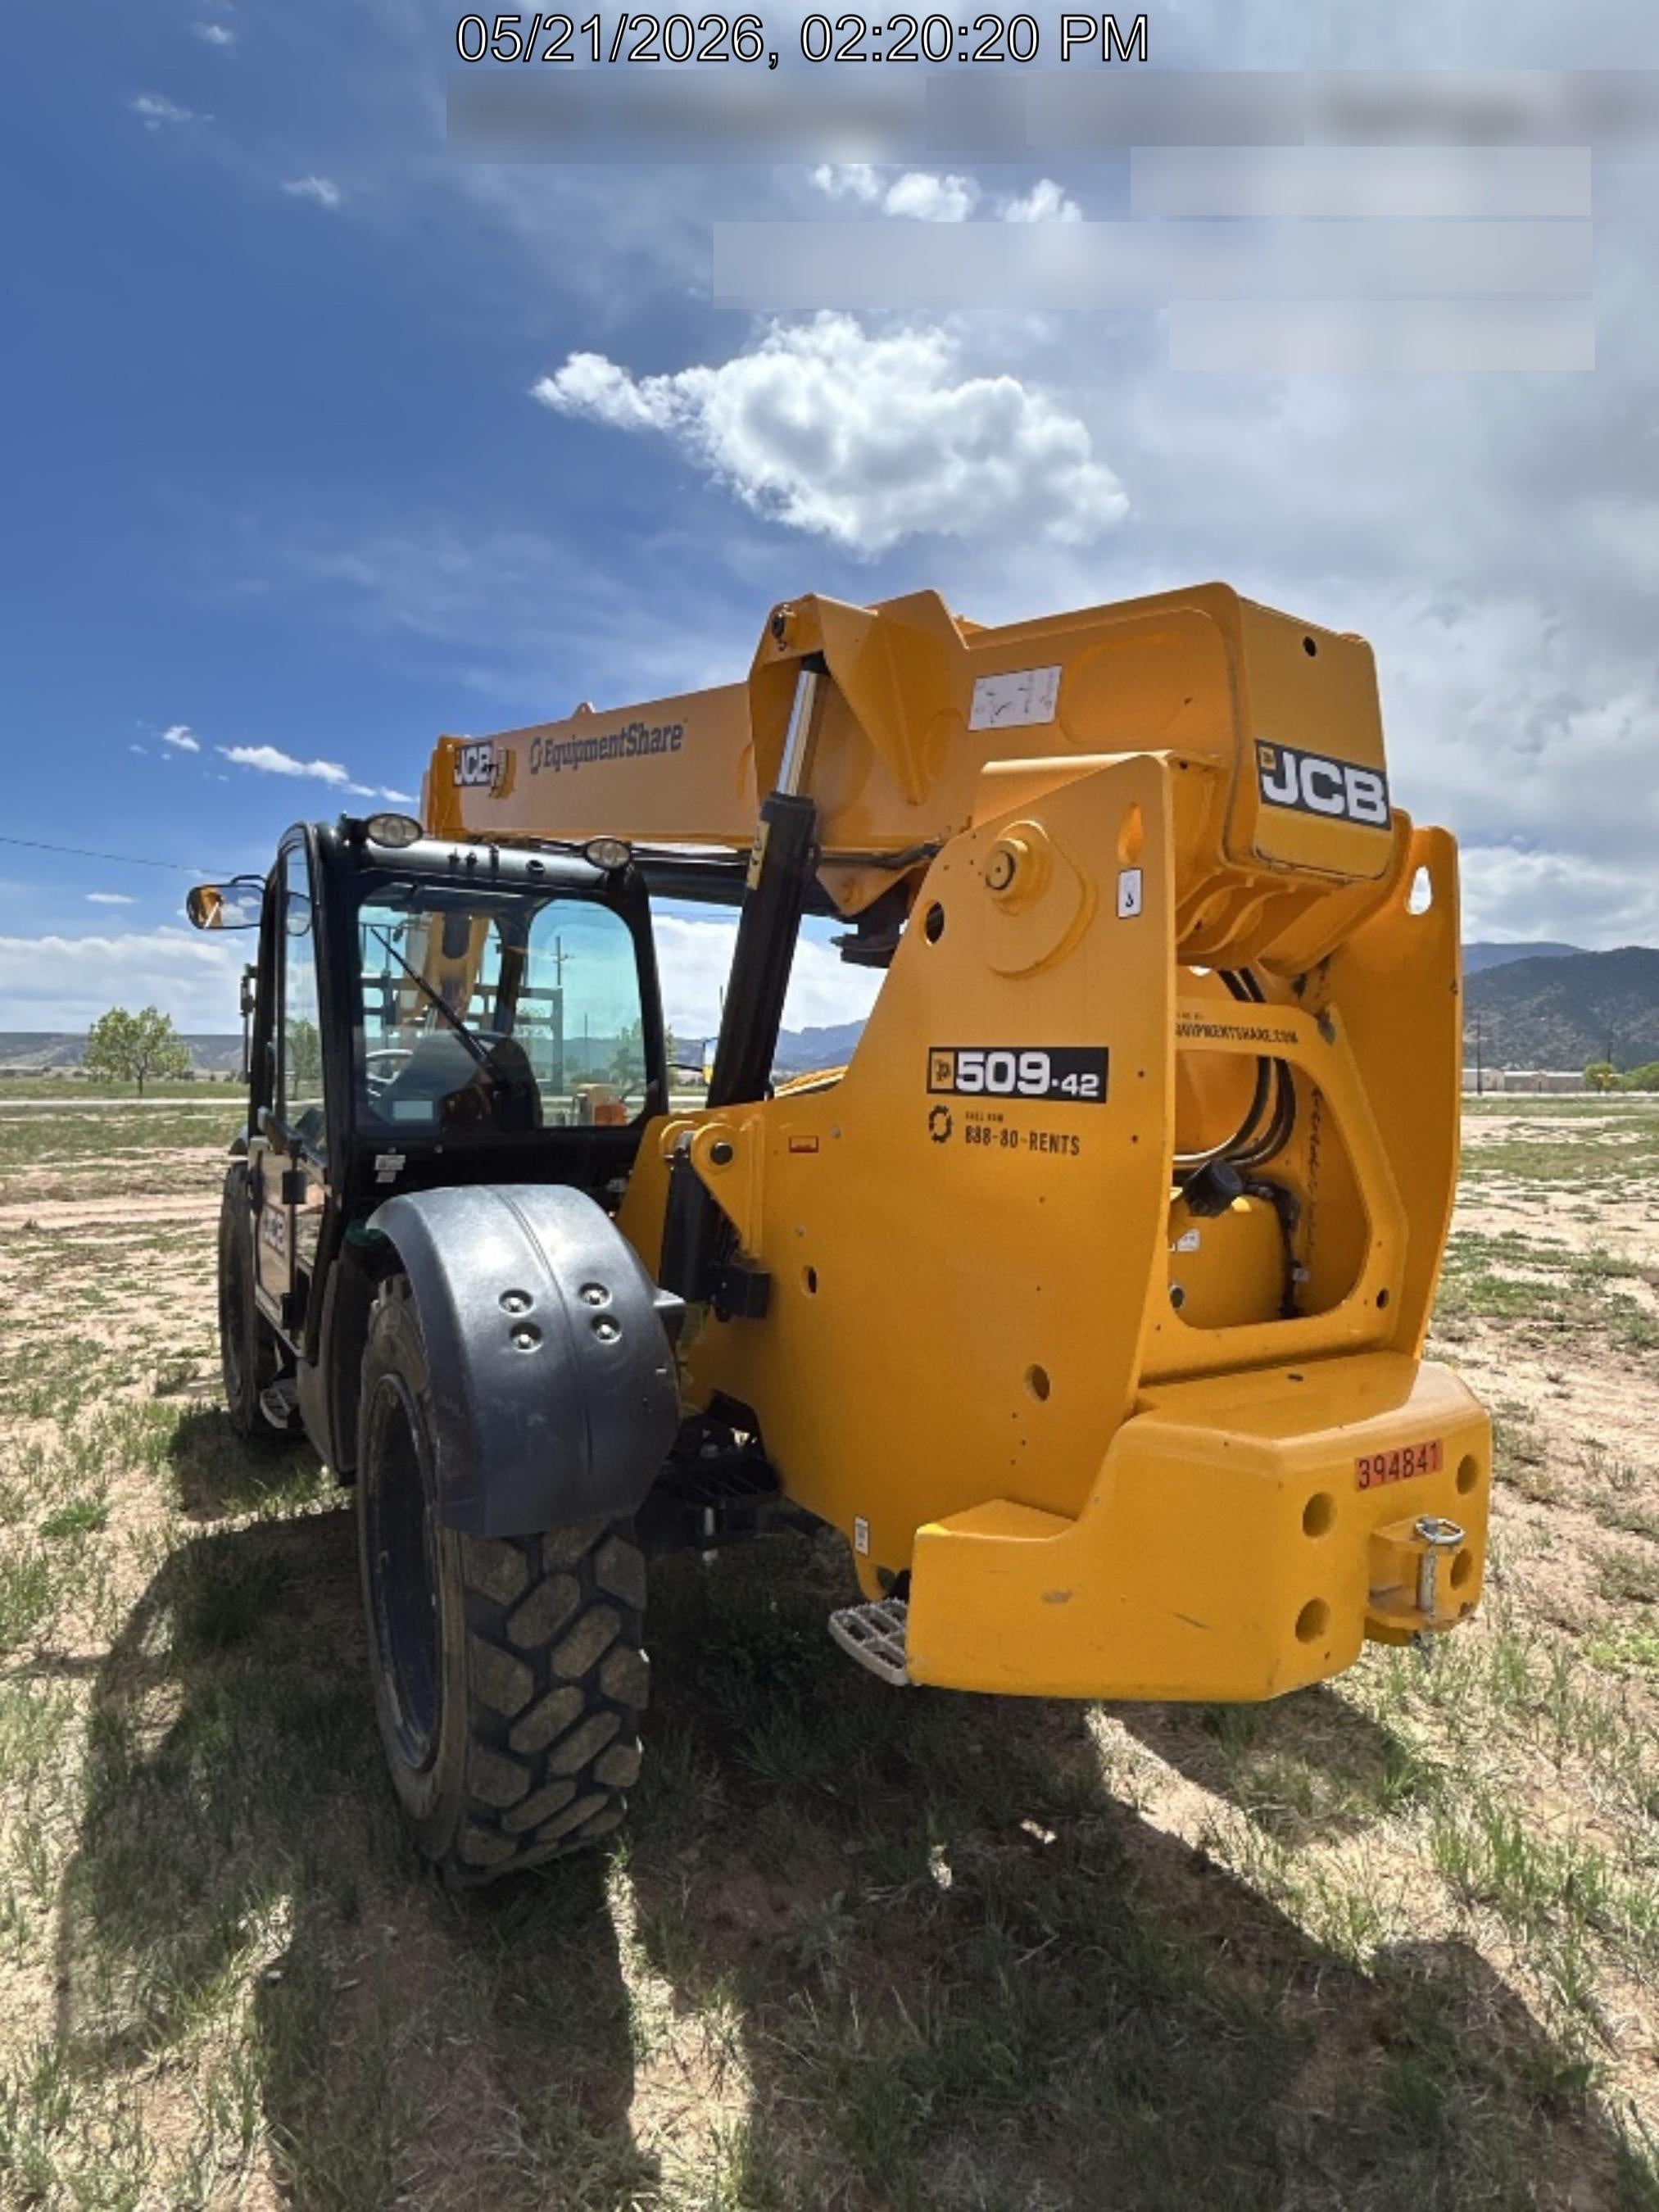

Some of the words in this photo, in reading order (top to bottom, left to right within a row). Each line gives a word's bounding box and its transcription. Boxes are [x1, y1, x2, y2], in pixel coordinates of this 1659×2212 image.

[543, 722, 683, 772] EquipmentShare
[1262, 750, 1388, 824] JCB
[1358, 1440, 1439, 1489] 394841
